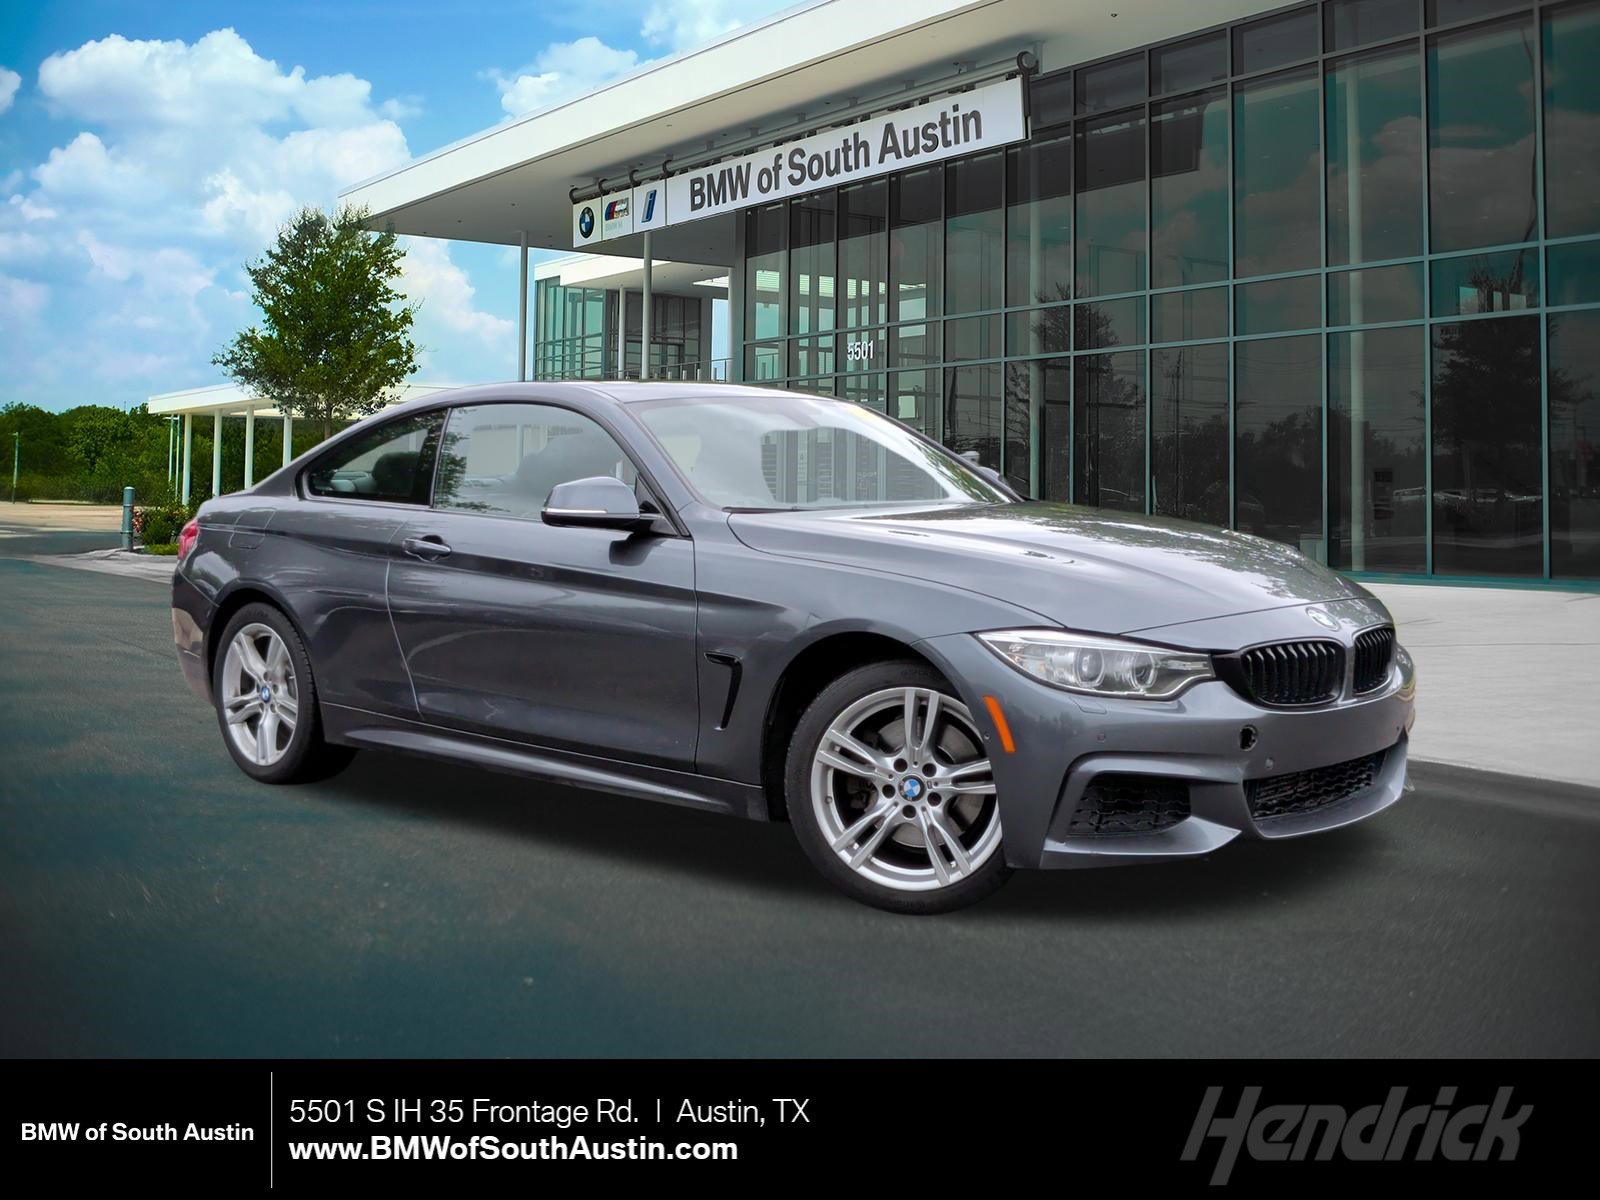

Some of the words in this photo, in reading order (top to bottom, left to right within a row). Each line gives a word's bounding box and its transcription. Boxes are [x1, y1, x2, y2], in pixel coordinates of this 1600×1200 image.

[690, 162, 751, 211] BMW
[757, 153, 782, 194] of
[788, 132, 870, 186] South
[878, 104, 982, 164] Austin
[847, 340, 874, 360] 5501
